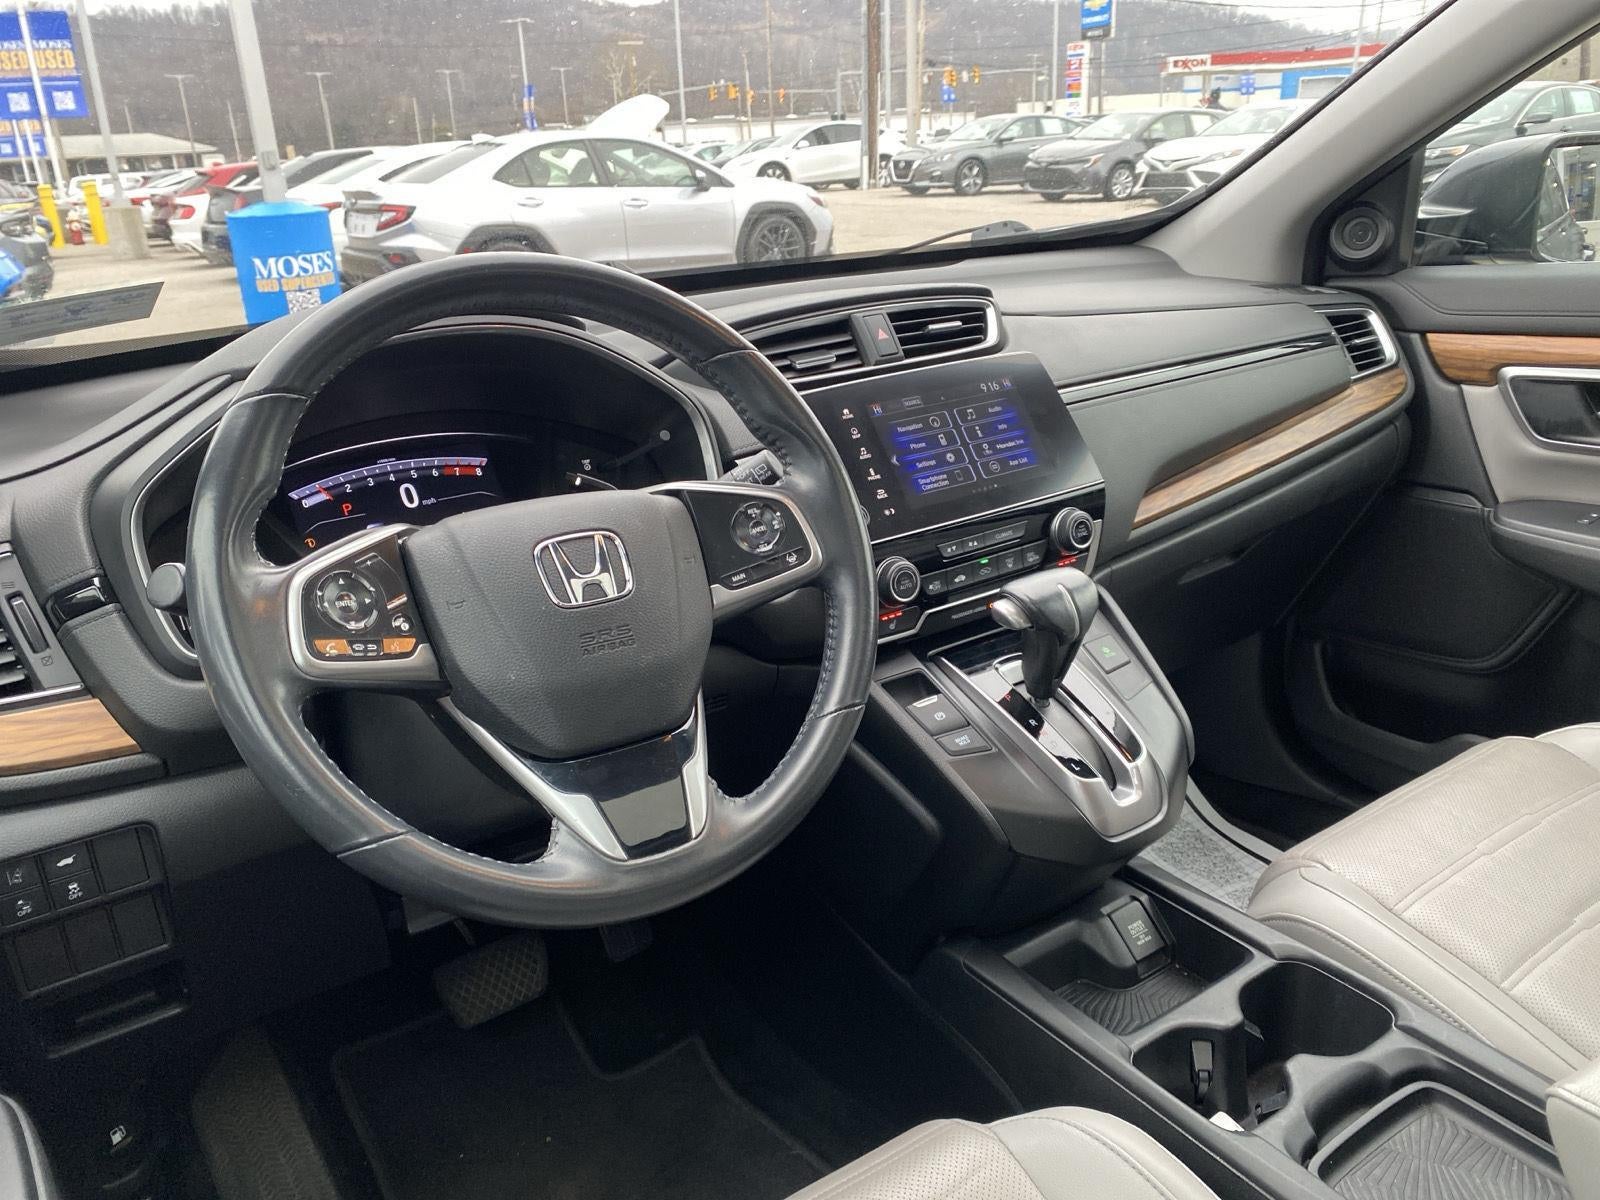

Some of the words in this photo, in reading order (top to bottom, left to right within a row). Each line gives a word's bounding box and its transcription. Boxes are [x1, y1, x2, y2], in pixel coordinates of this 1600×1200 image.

[1173, 58, 1207, 70] EXXON
[252, 251, 333, 278] MOSES
[344, 483, 353, 493] 2
[366, 477, 374, 486] 3
[389, 473, 396, 482] 4
[410, 469, 418, 479] 5
[432, 468, 439, 477] 6
[453, 467, 460, 476] 7
[475, 467, 483, 476] 8
[399, 482, 419, 509] 0
[422, 497, 437, 506] mph
[342, 503, 352, 516] P
[732, 573, 746, 582] MAIN
[580, 625, 632, 645] SRS
[583, 639, 636, 656] AIRBAG
[1028, 718, 1039, 727] R
[1070, 762, 1080, 771] L
[69, 891, 83, 900] OFF
[17, 908, 32, 917] OFF
